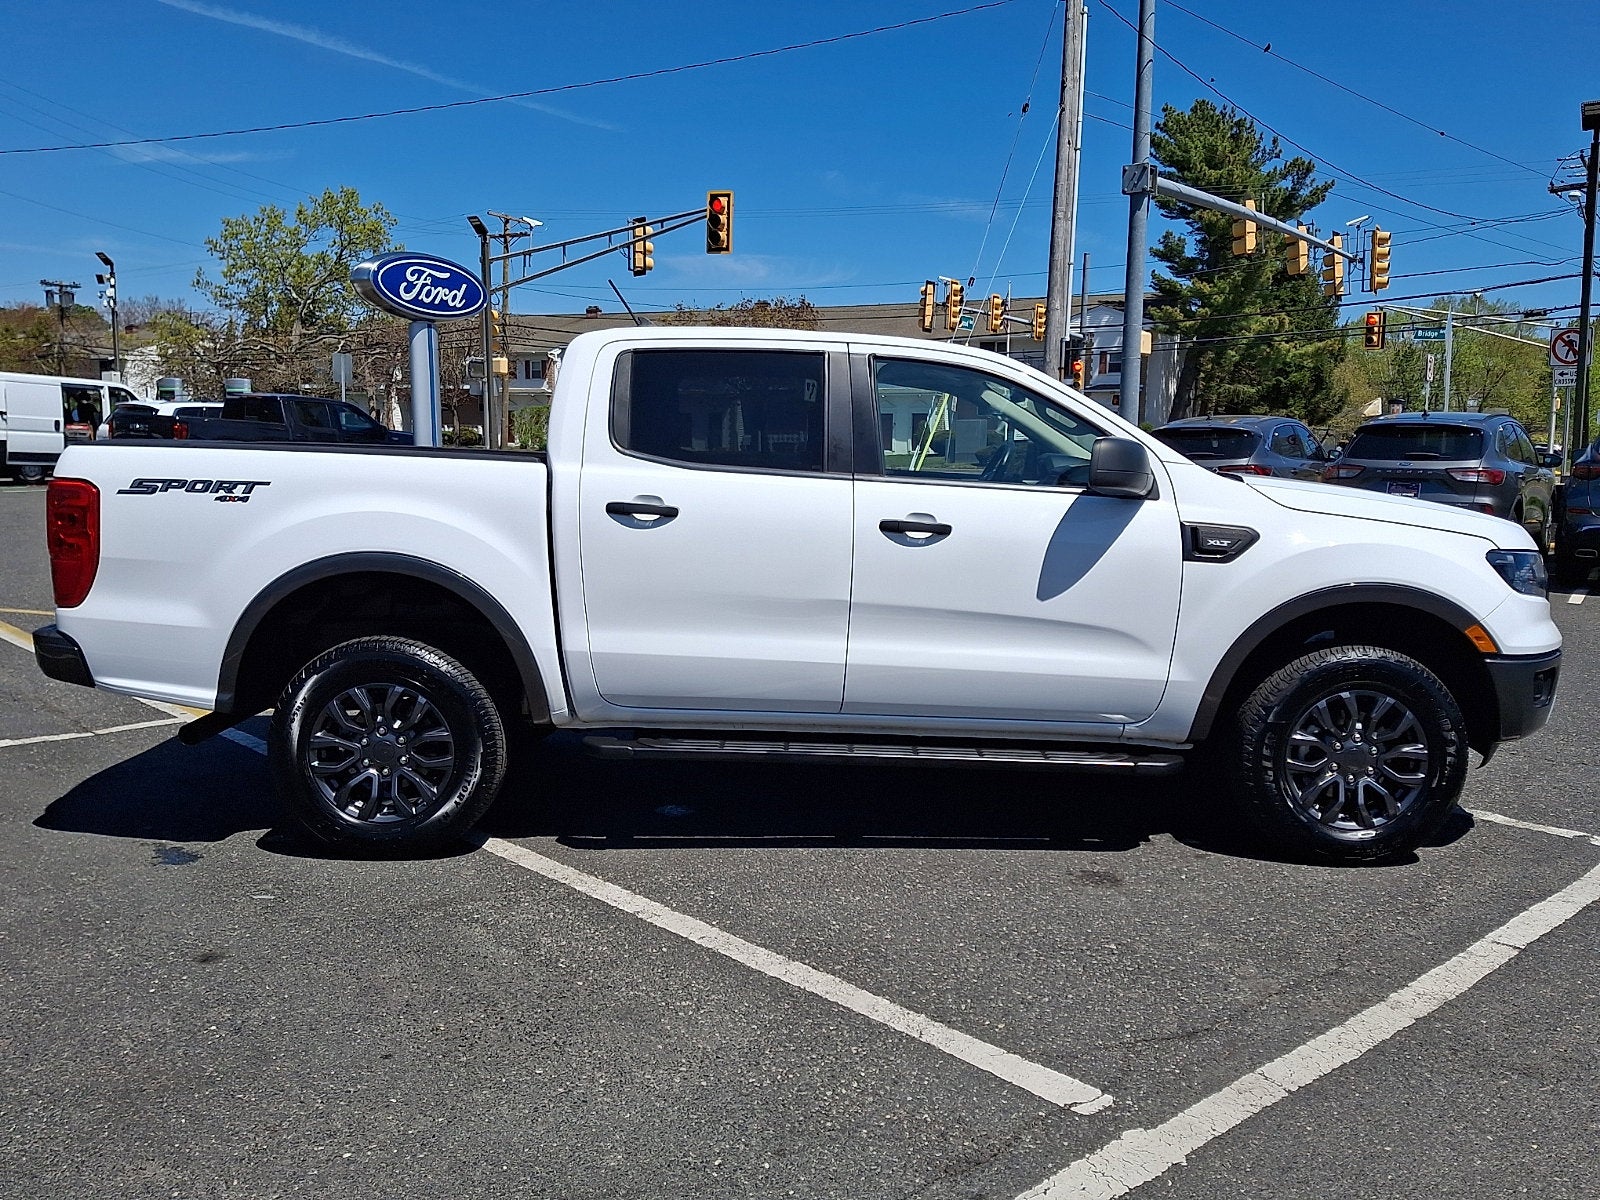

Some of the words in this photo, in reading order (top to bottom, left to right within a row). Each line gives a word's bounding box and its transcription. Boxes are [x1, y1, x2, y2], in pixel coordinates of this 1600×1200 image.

[400, 265, 467, 308] Ford
[1417, 329, 1439, 339] Bridge
[116, 478, 272, 495] SPORT
[1206, 539, 1232, 547] XLT
